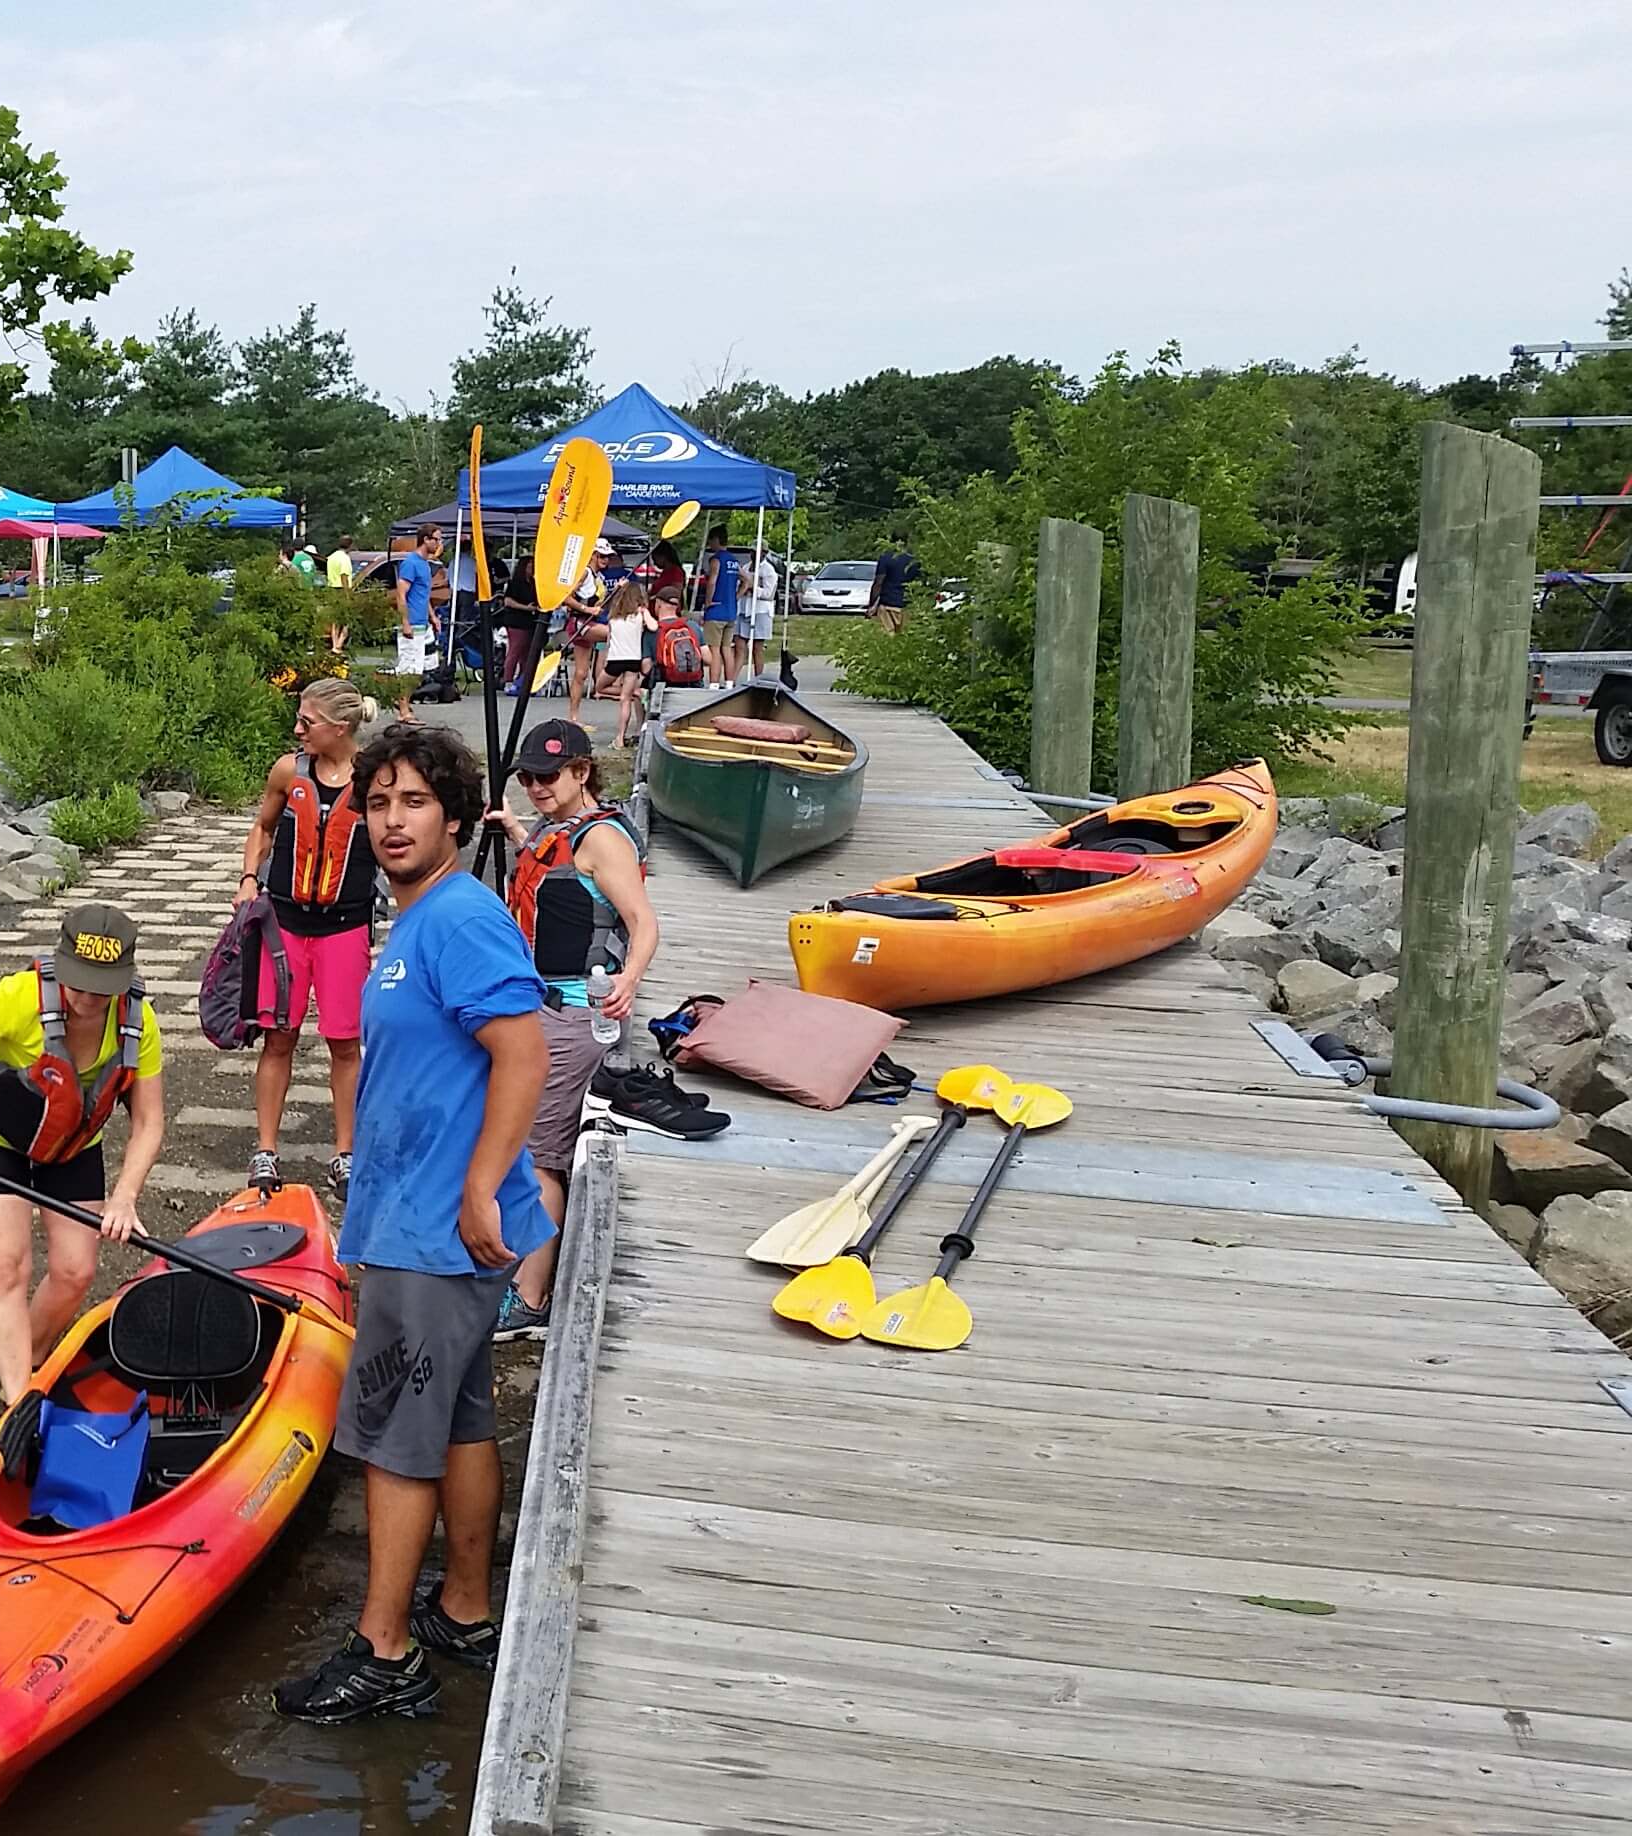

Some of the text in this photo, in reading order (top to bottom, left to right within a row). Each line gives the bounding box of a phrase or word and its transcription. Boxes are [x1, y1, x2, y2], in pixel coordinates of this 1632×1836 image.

[548, 443, 656, 455] PDLE
[74, 932, 87, 955] THE
[83, 935, 122, 961] BOSS
[356, 1336, 408, 1400] NIKE
[411, 1355, 433, 1396] SB
